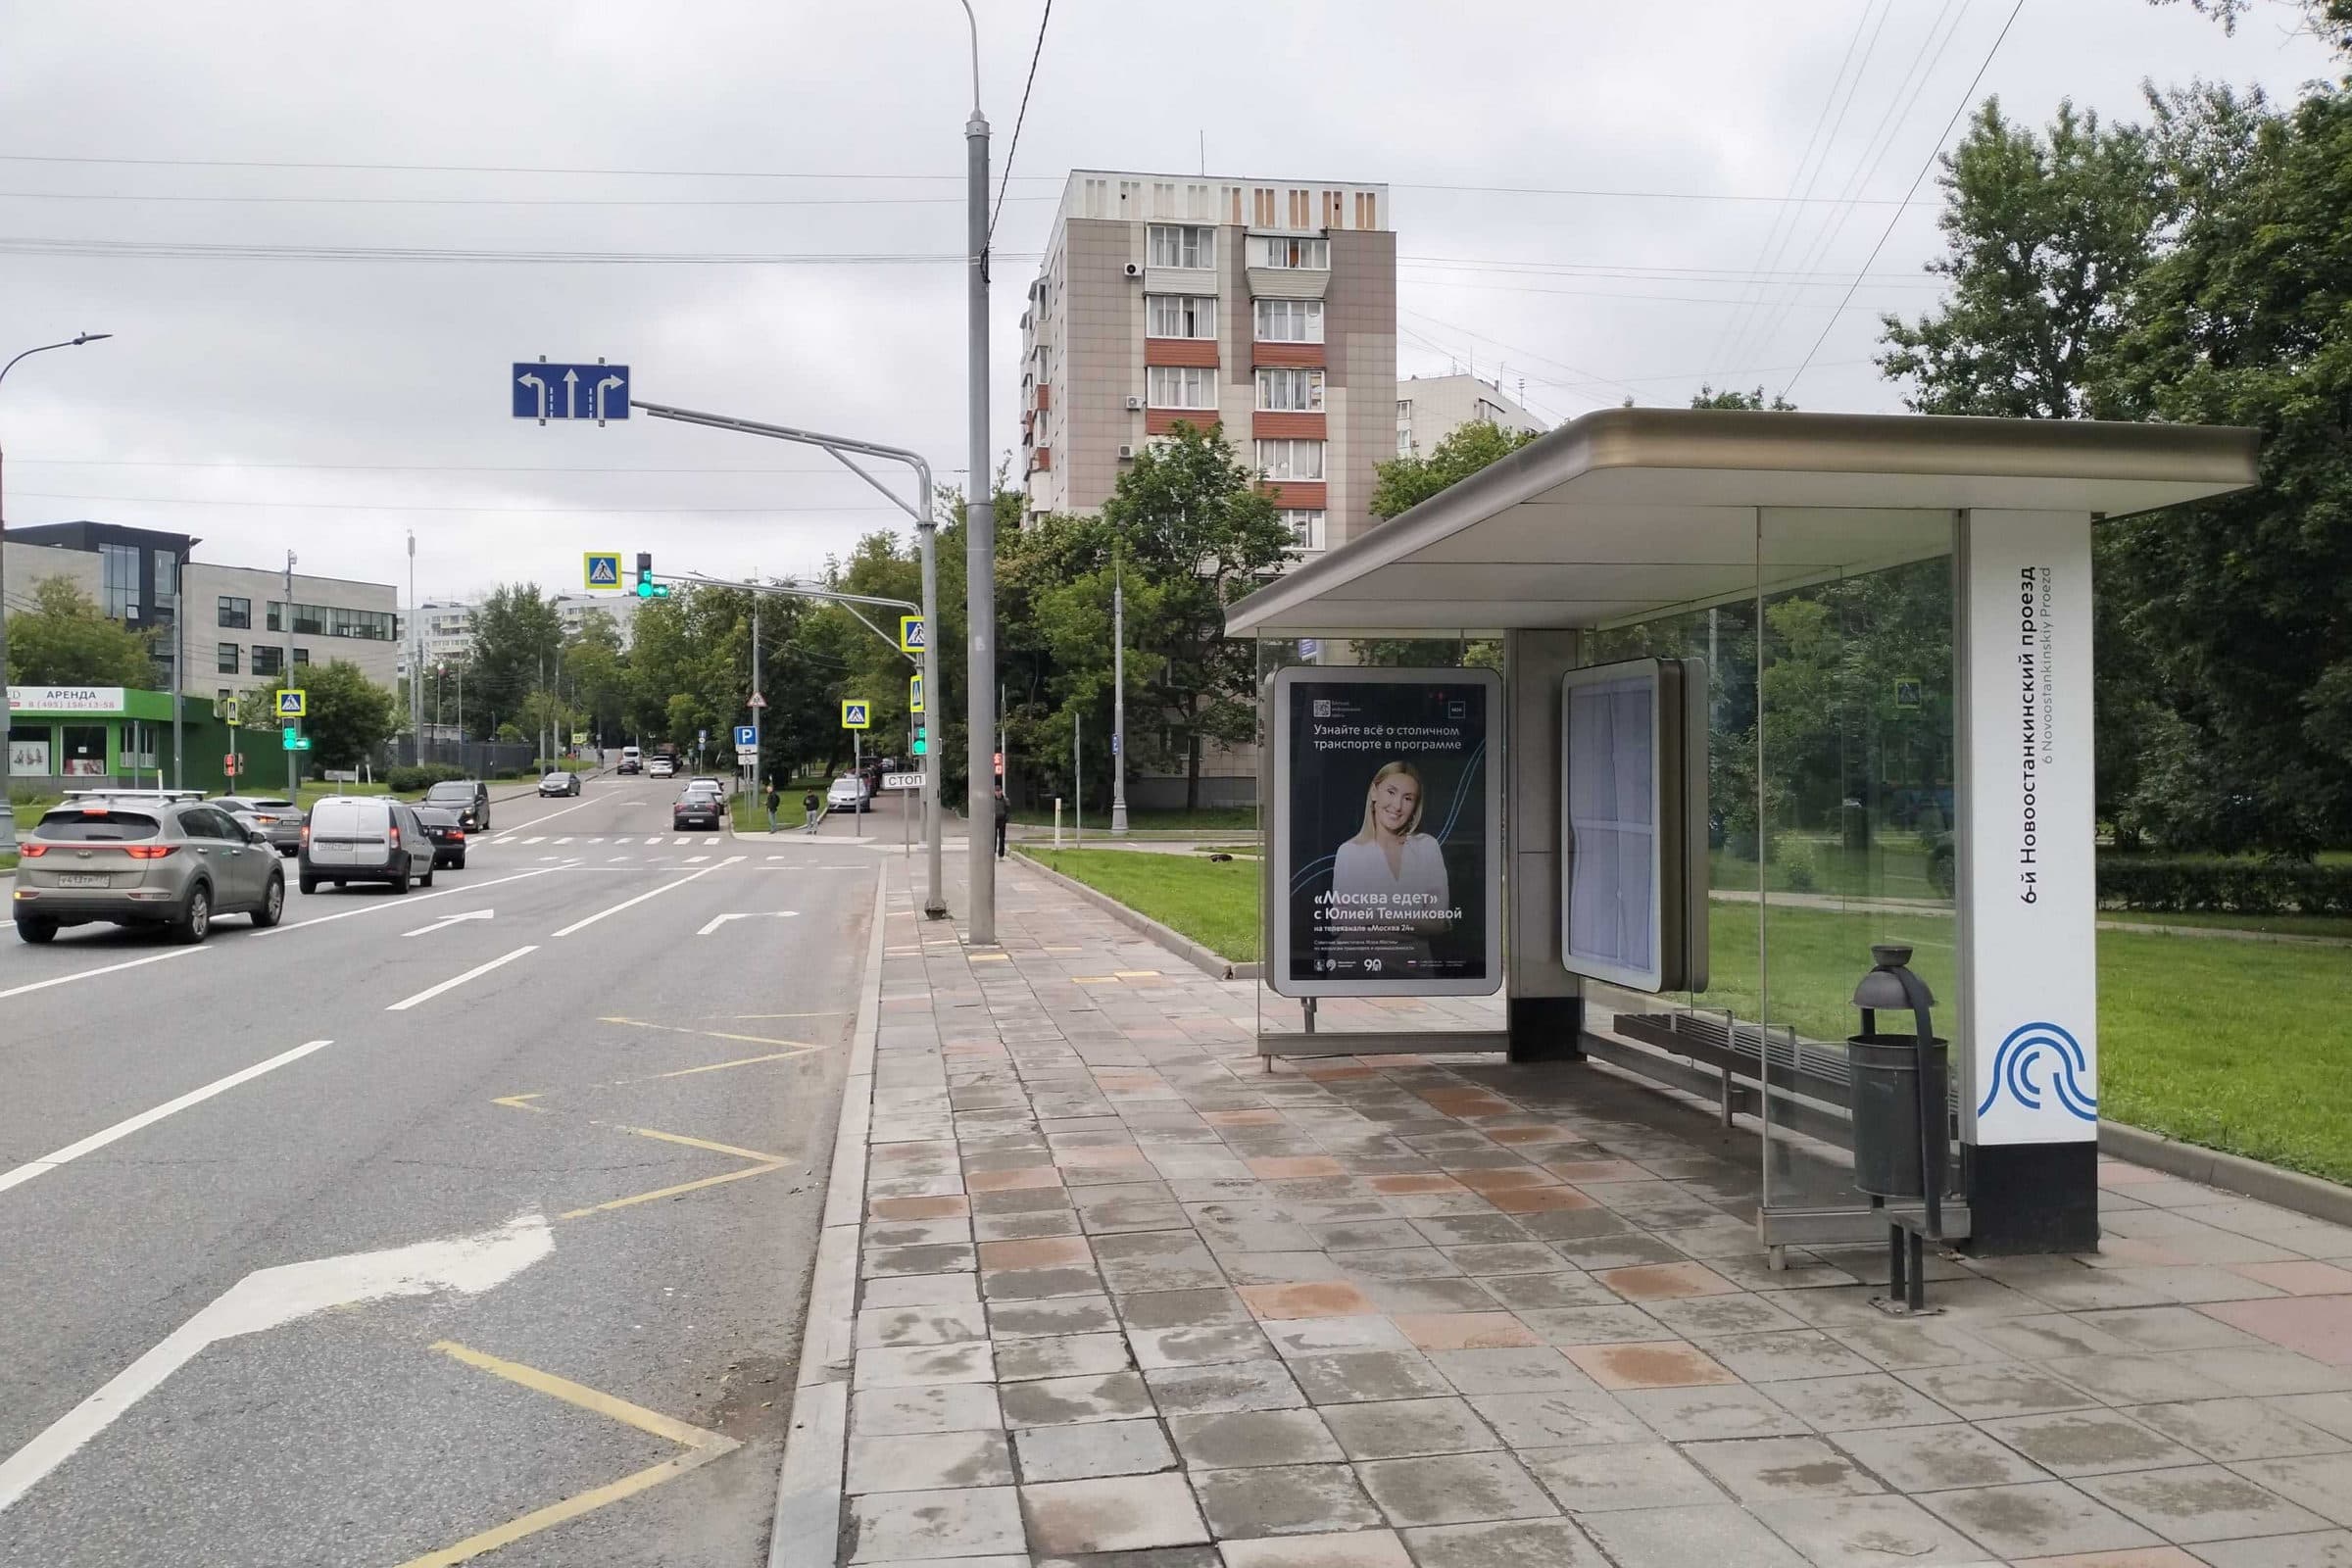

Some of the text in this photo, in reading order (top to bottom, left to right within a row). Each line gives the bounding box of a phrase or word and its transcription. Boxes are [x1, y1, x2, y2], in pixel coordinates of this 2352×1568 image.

[2039, 566, 2054, 764] 6 Novoostankinskiy Proezd
[46, 690, 96, 700] АРЕНДА
[742, 728, 753, 744] P
[1313, 723, 1360, 735] Узнайте
[1363, 724, 1384, 735] всё
[1396, 727, 1459, 736] столичном
[2018, 566, 2037, 904] 6-й Новоостанкинский проезд
[1314, 740, 1382, 752] транспорте
[1395, 741, 1462, 752] программе
[888, 775, 922, 786] СТОП
[1314, 890, 1438, 906] «Москва едет»
[1314, 906, 1462, 920] с Юлией Темниковой
